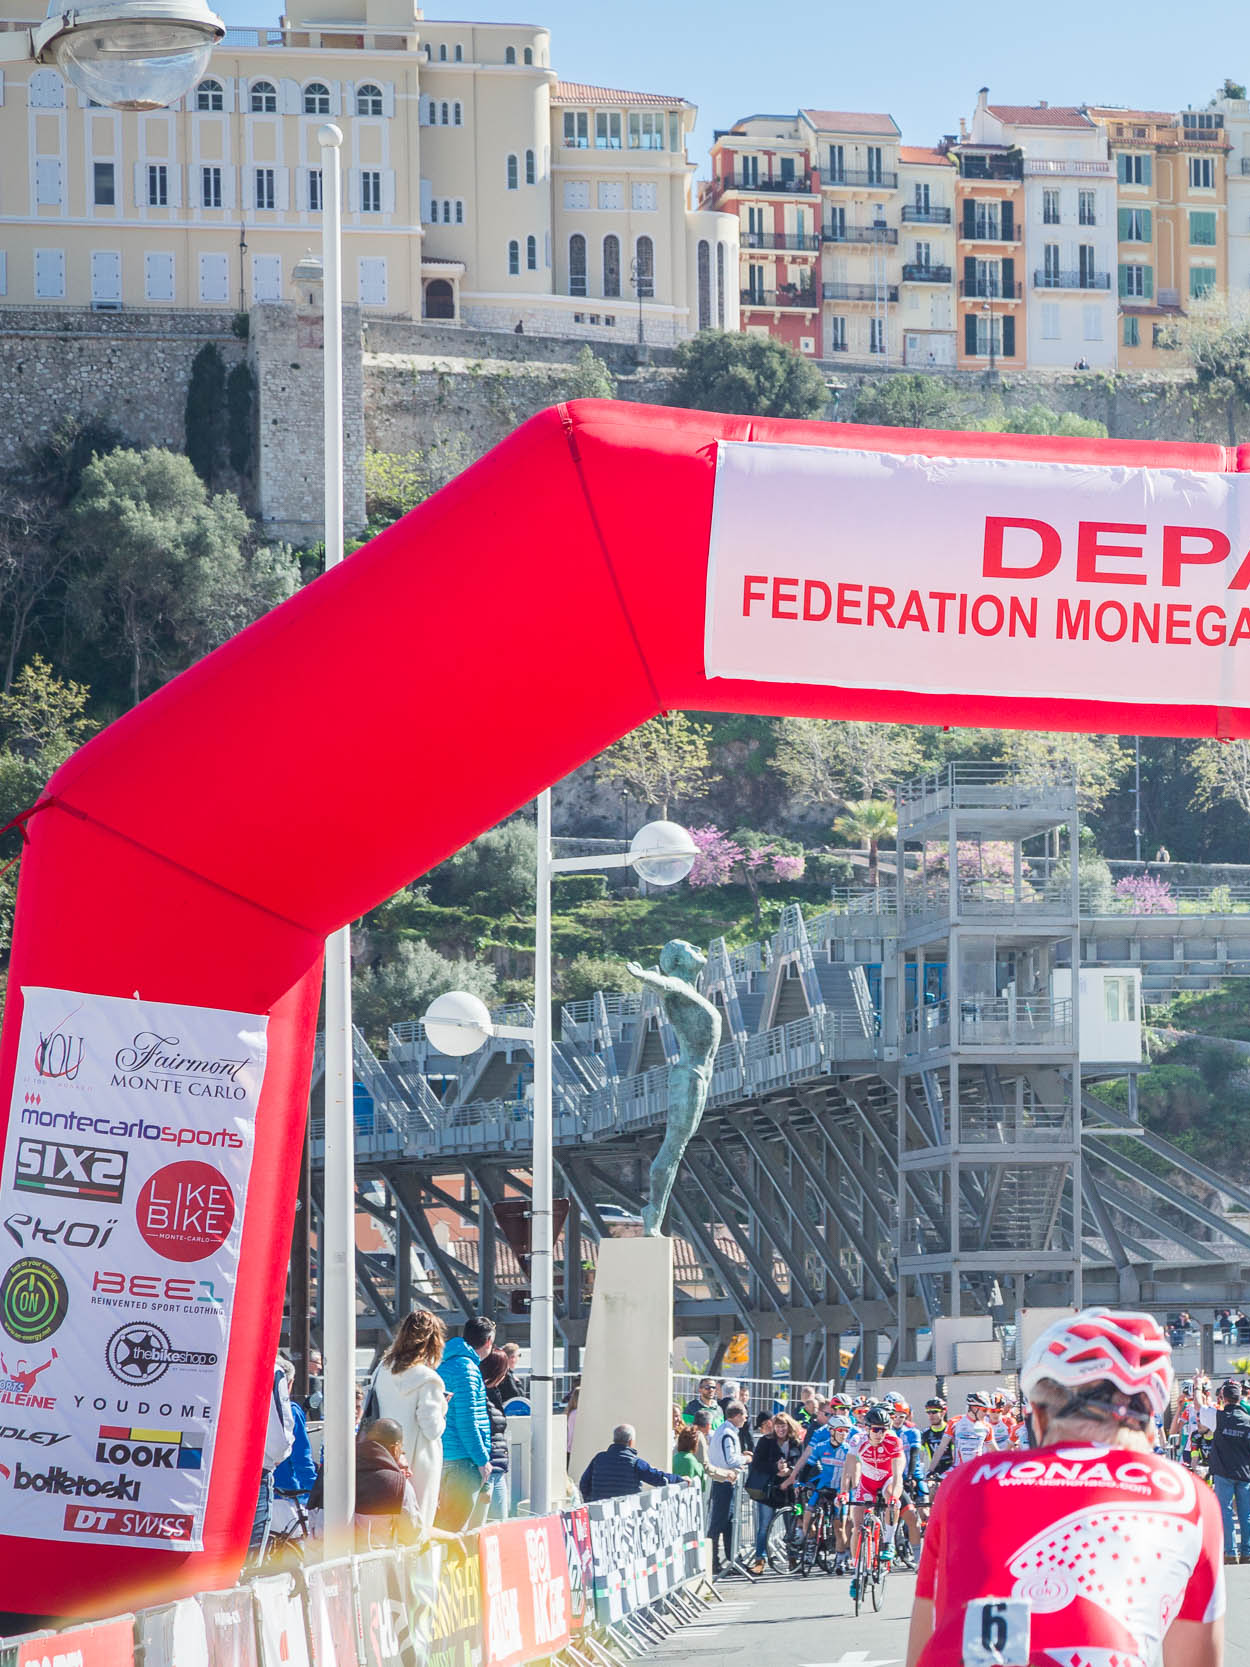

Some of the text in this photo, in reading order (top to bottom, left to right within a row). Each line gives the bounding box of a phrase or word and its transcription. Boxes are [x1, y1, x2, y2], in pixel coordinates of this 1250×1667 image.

[741, 574, 1038, 640] FEDERATION
[115, 1031, 253, 1083] Fairmont
[110, 1073, 182, 1094] MONTE
[188, 1082, 247, 1101] CARLO
[21, 1107, 244, 1149] montecarlosports
[149, 1179, 228, 1209] LIKE
[146, 1204, 225, 1235] BIKE
[159, 1233, 210, 1243] MONTE-CARLO
[20, 1291, 40, 1313] ON
[91, 1296, 224, 1316] REINVENTED SPORT CLOTHING
[96, 1441, 177, 1469] LOOK
[970, 1460, 1182, 1495] MONACO
[74, 1509, 187, 1537] DT SWISS
[981, 1602, 1008, 1654] 6
